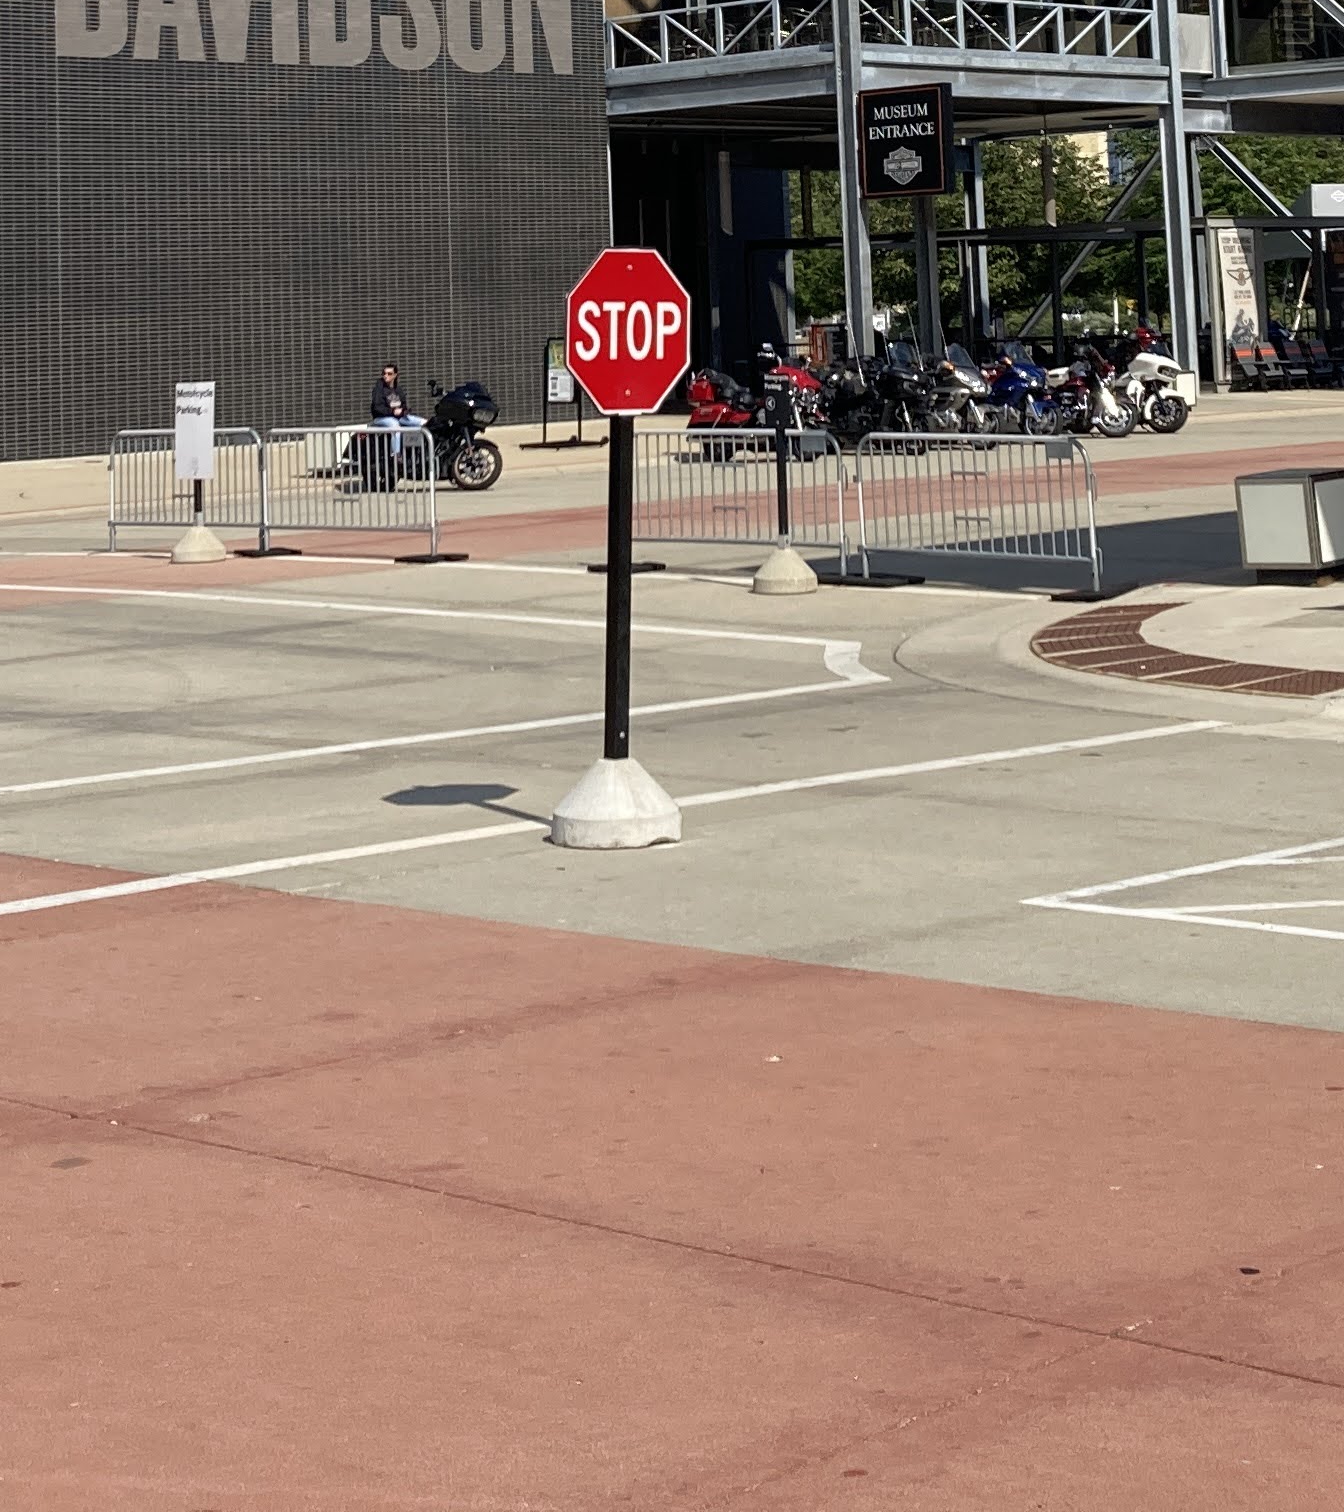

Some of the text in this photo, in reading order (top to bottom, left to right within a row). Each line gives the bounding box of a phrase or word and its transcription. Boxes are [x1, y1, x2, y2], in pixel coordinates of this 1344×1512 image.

[873, 102, 929, 121] MUSEUM
[868, 121, 936, 140] ENTRANCE
[575, 300, 682, 362] STOP
